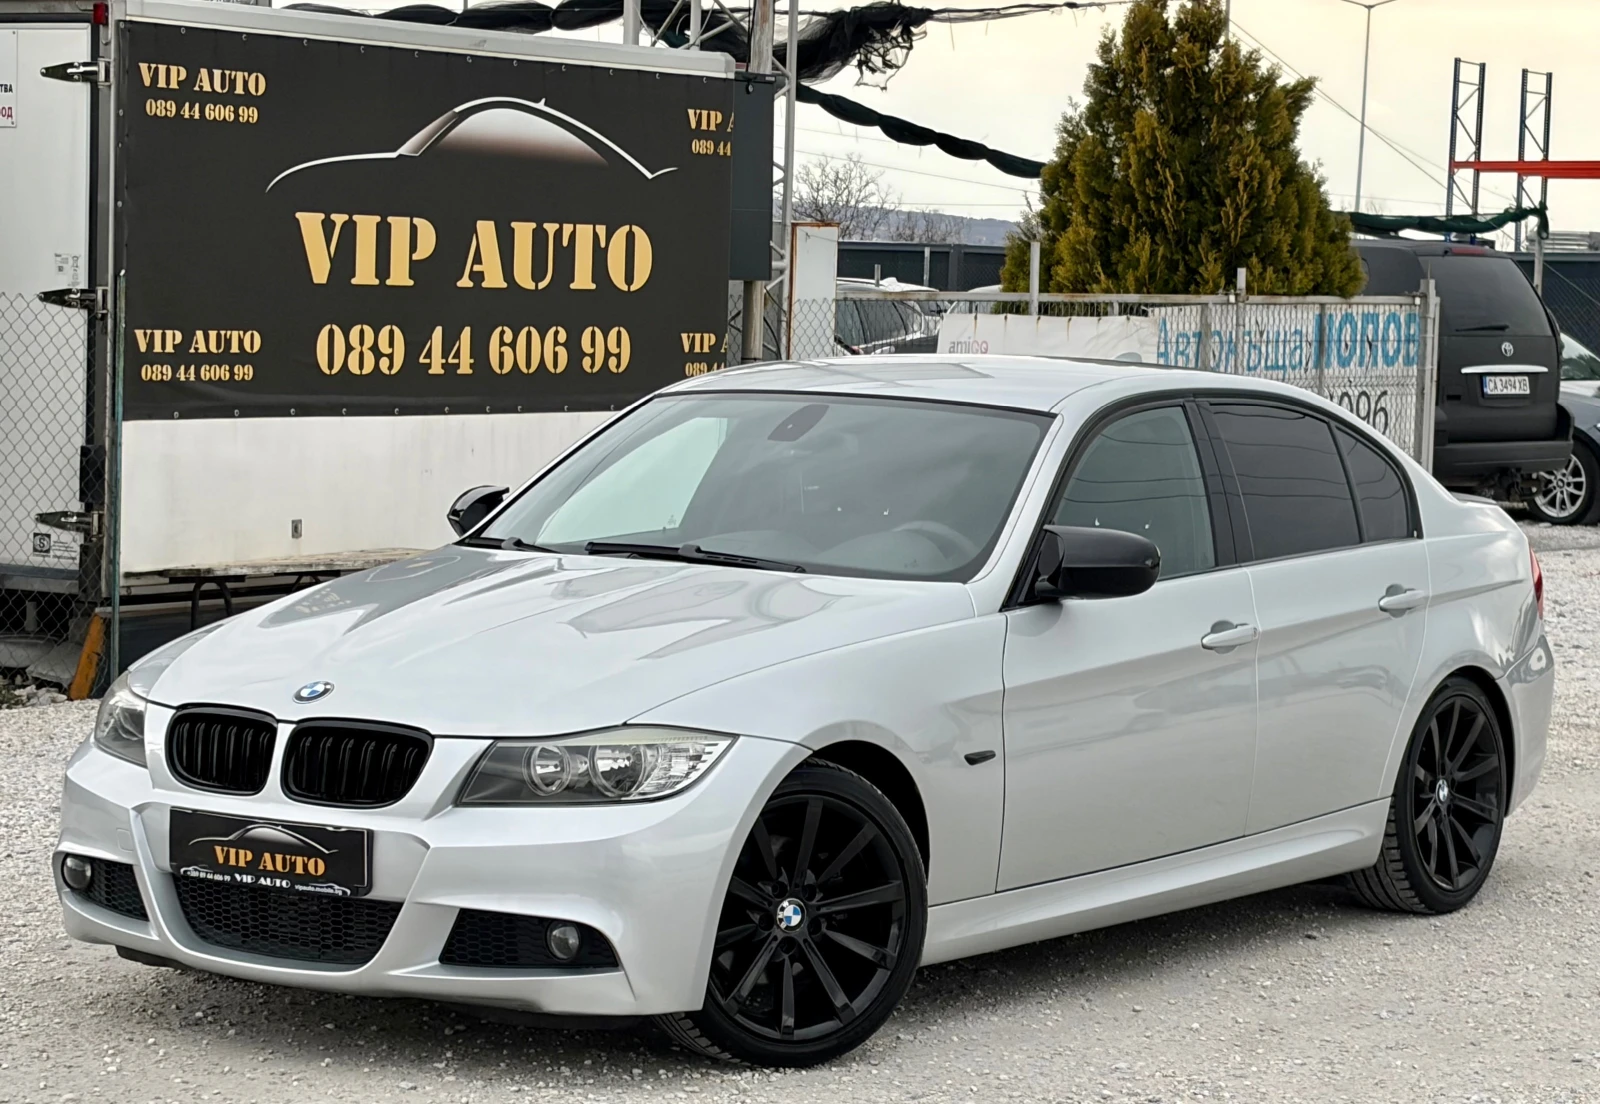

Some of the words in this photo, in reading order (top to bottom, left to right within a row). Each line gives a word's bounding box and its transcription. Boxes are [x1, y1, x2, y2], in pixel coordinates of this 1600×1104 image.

[138, 62, 187, 89] VIP
[193, 67, 266, 96] AUTO
[0, 106, 13, 119] ОД
[145, 98, 177, 118] 089
[180, 101, 200, 120] 44
[204, 103, 235, 122] 606
[238, 105, 258, 124] 99
[687, 108, 723, 131] VIP
[691, 138, 715, 155] 089
[716, 140, 731, 156] 44
[295, 211, 437, 287] VIP
[456, 220, 653, 292] AUTO
[134, 329, 183, 353] VIP
[188, 329, 262, 354] AUTO
[316, 323, 405, 375] 089
[418, 325, 475, 375] 44
[488, 325, 569, 375] 606
[580, 325, 631, 374] 99
[680, 332, 716, 353] VIP
[141, 363, 172, 381] 089
[175, 363, 196, 381] 44
[200, 363, 231, 381] 606
[233, 363, 254, 381] 99
[685, 361, 708, 377] 089
[213, 845, 253, 868] VIP
[258, 851, 326, 876] AUTO
[234, 873, 256, 884] VIP
[257, 876, 291, 888] AUTO
